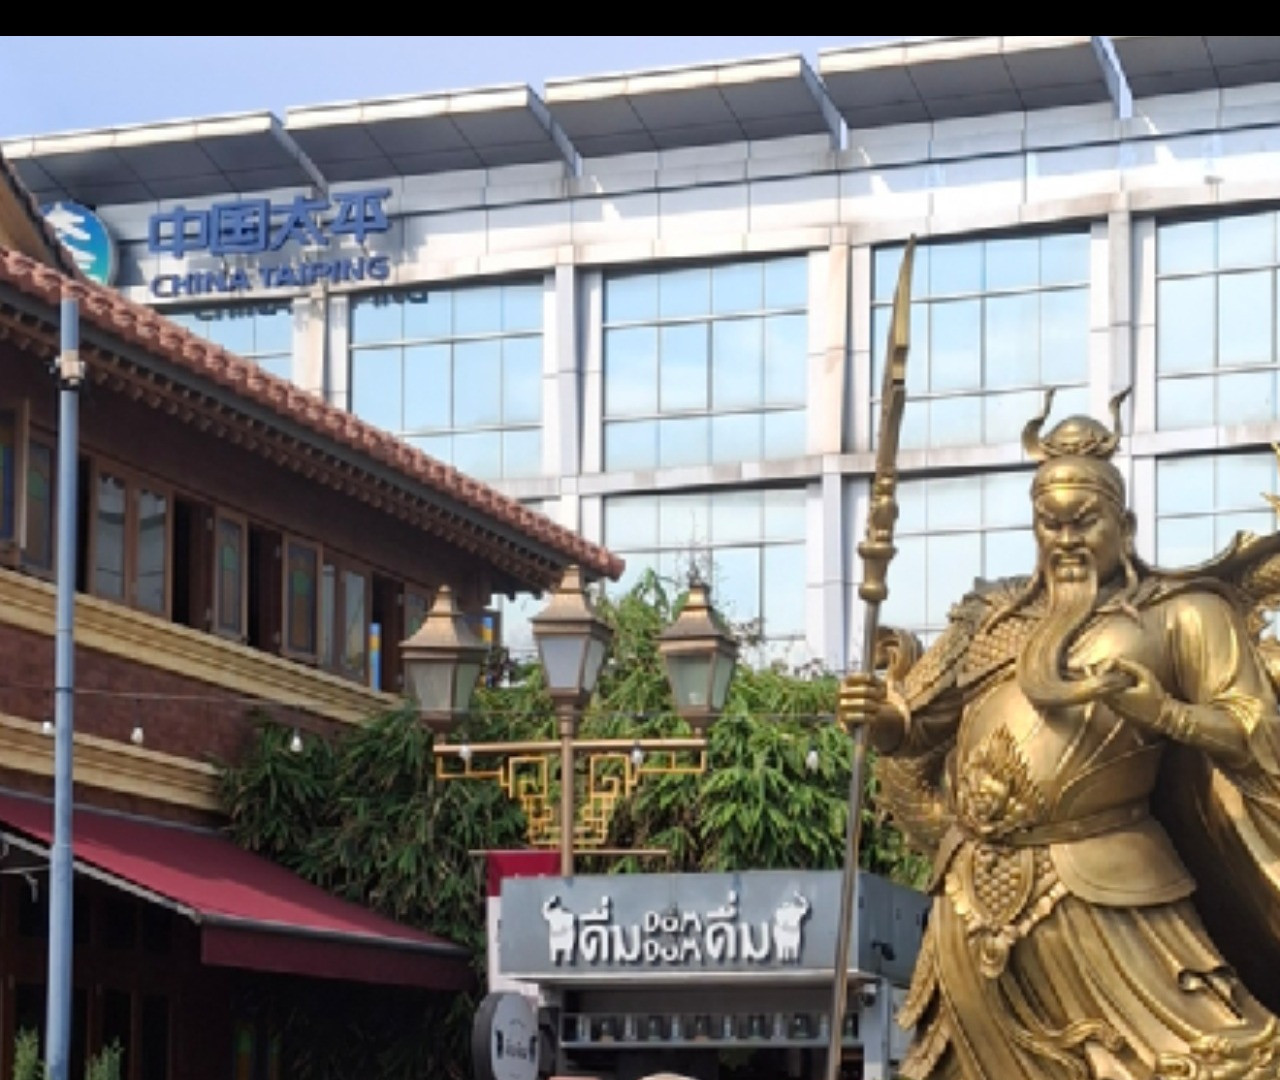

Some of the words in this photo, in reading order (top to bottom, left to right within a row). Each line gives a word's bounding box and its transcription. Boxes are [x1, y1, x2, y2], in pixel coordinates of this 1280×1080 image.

[149, 187, 393, 259] 中国太平
[151, 269, 252, 298] CHINA
[257, 256, 391, 288] TAIPING
